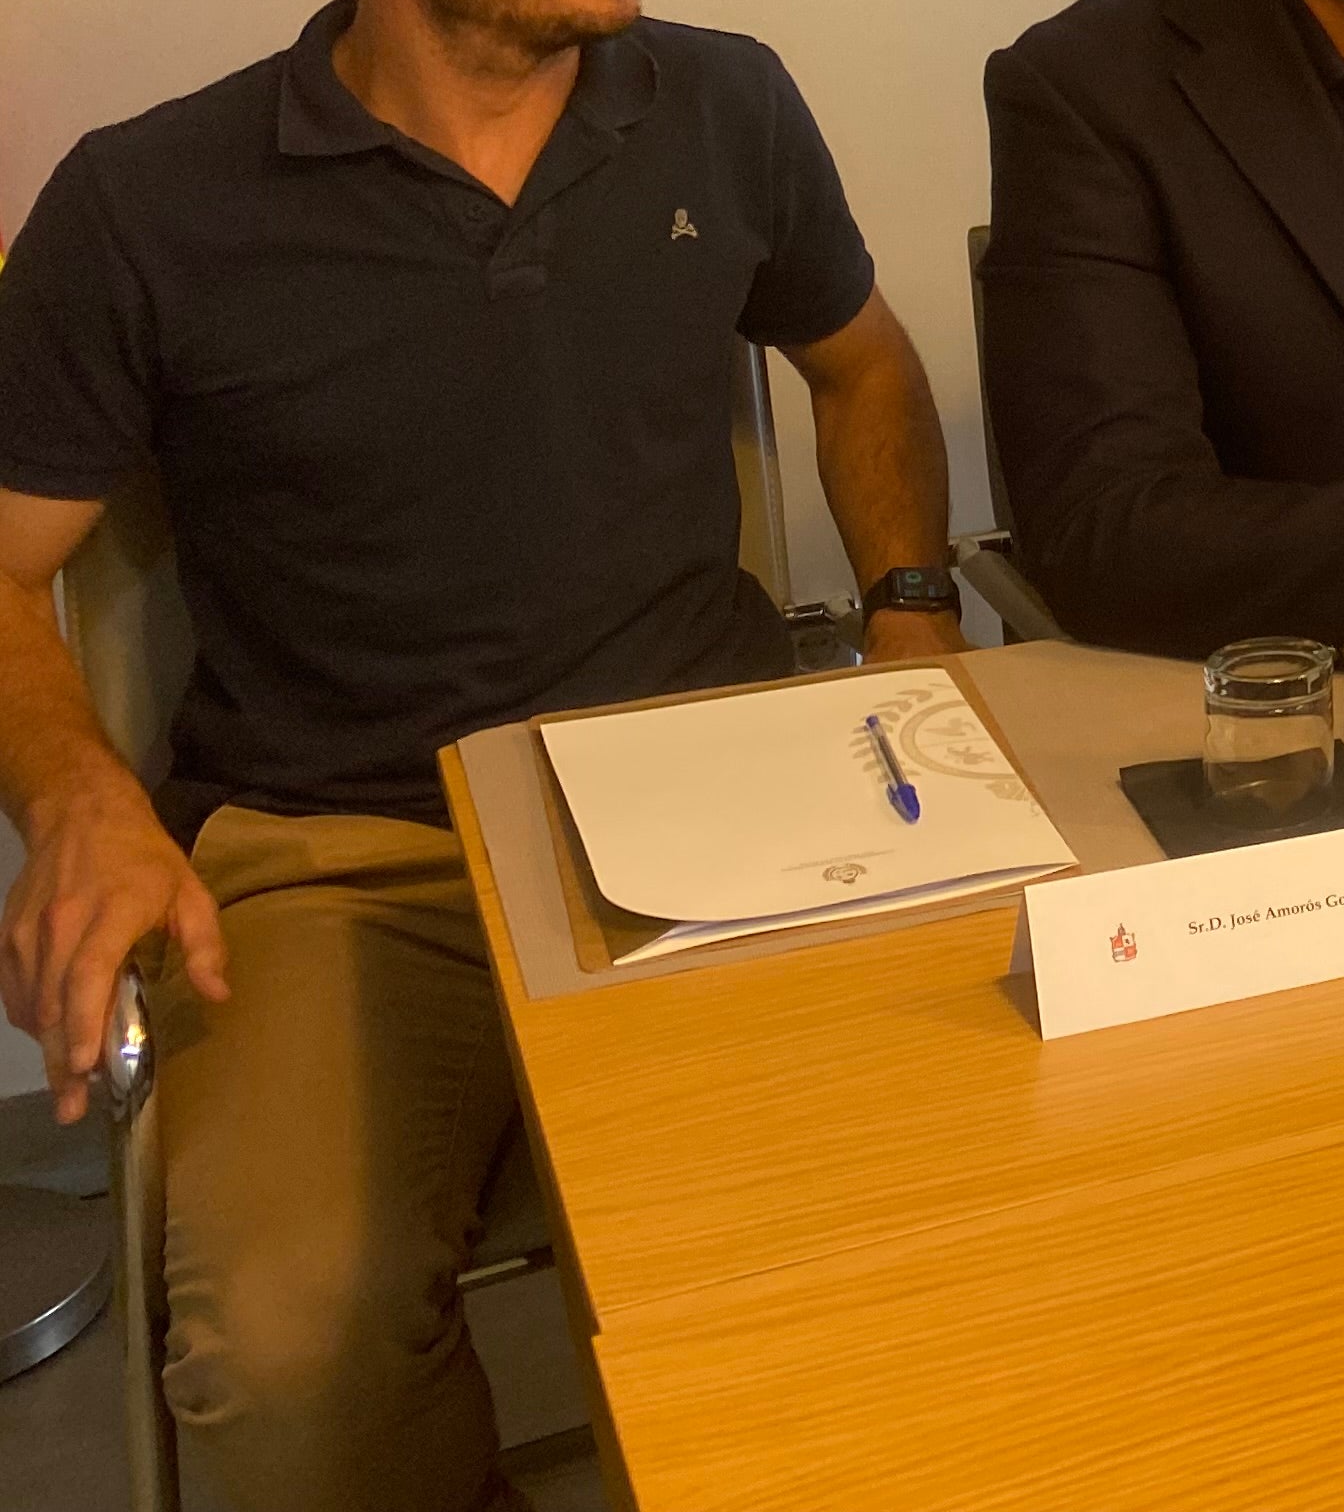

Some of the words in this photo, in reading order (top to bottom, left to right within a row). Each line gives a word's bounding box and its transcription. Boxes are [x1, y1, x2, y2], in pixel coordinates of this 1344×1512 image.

[1188, 916, 1227, 935] Sr.D.
[1230, 909, 1261, 930] José
[1265, 899, 1322, 921] Amorós
